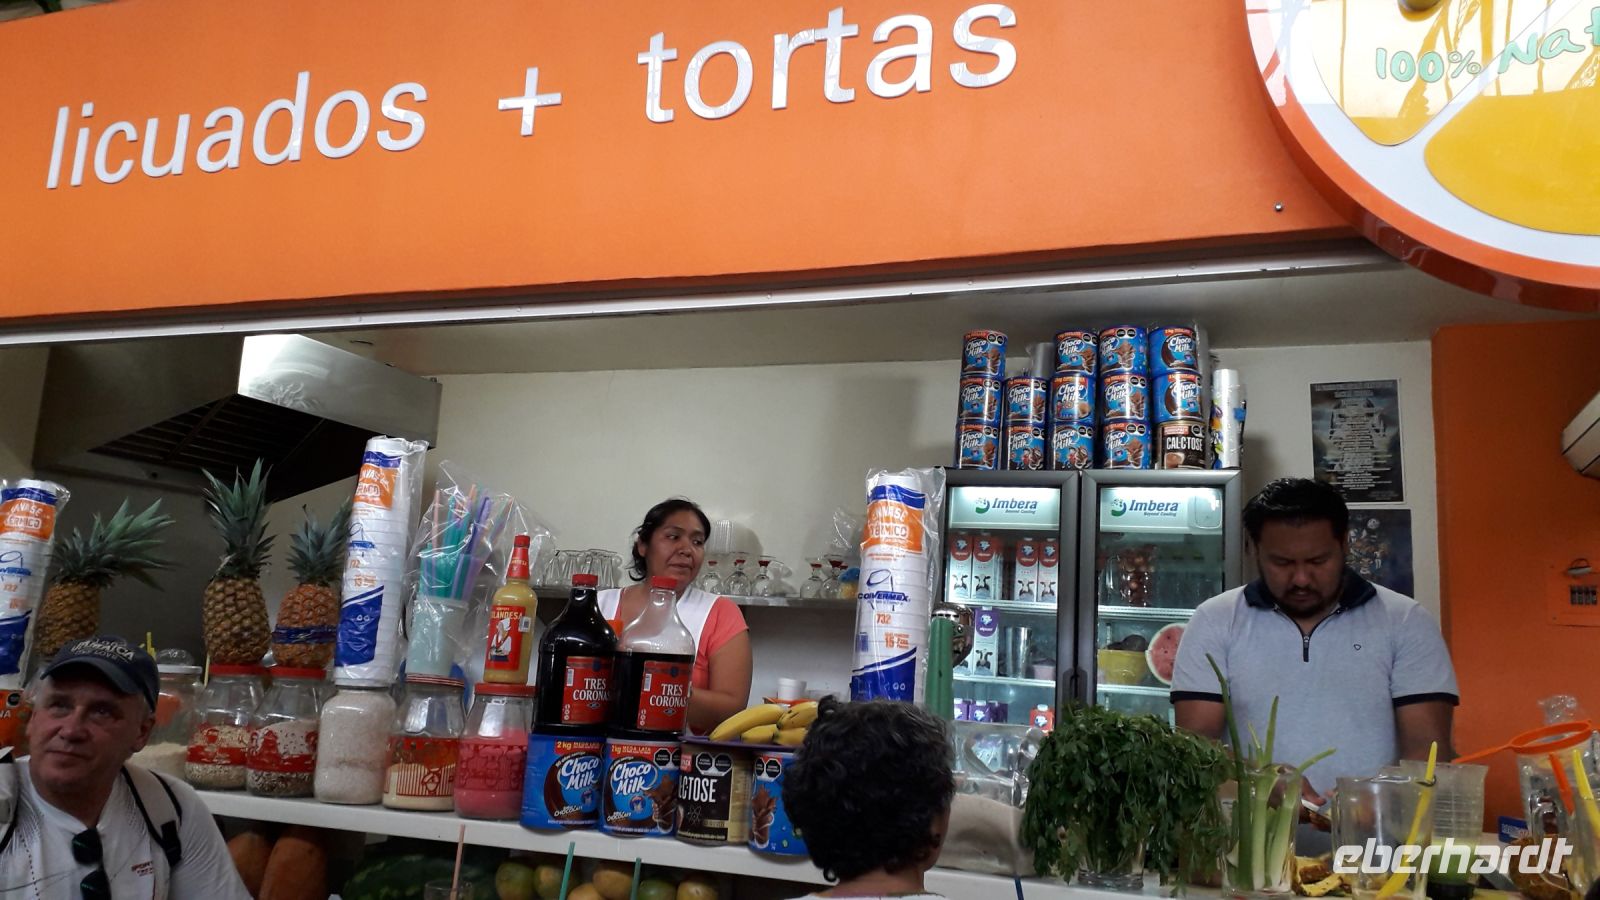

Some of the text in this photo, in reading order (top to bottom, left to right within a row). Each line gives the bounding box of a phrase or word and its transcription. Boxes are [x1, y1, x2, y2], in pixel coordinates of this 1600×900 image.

[1375, 47, 1482, 83] 100%
[45, 70, 428, 190] licuados
[637, 3, 1018, 123] tortas
[1169, 336, 1192, 347] Choco
[992, 498, 1038, 510] Imbera
[1129, 500, 1179, 512] Imbera
[876, 613, 892, 625] 732
[584, 678, 606, 690] TRES
[661, 684, 683, 696] TRES
[649, 696, 687, 708] CORONAS
[562, 758, 599, 777] Choco
[613, 763, 652, 781] Choco
[566, 771, 598, 790] Milk
[616, 776, 649, 795] Milk
